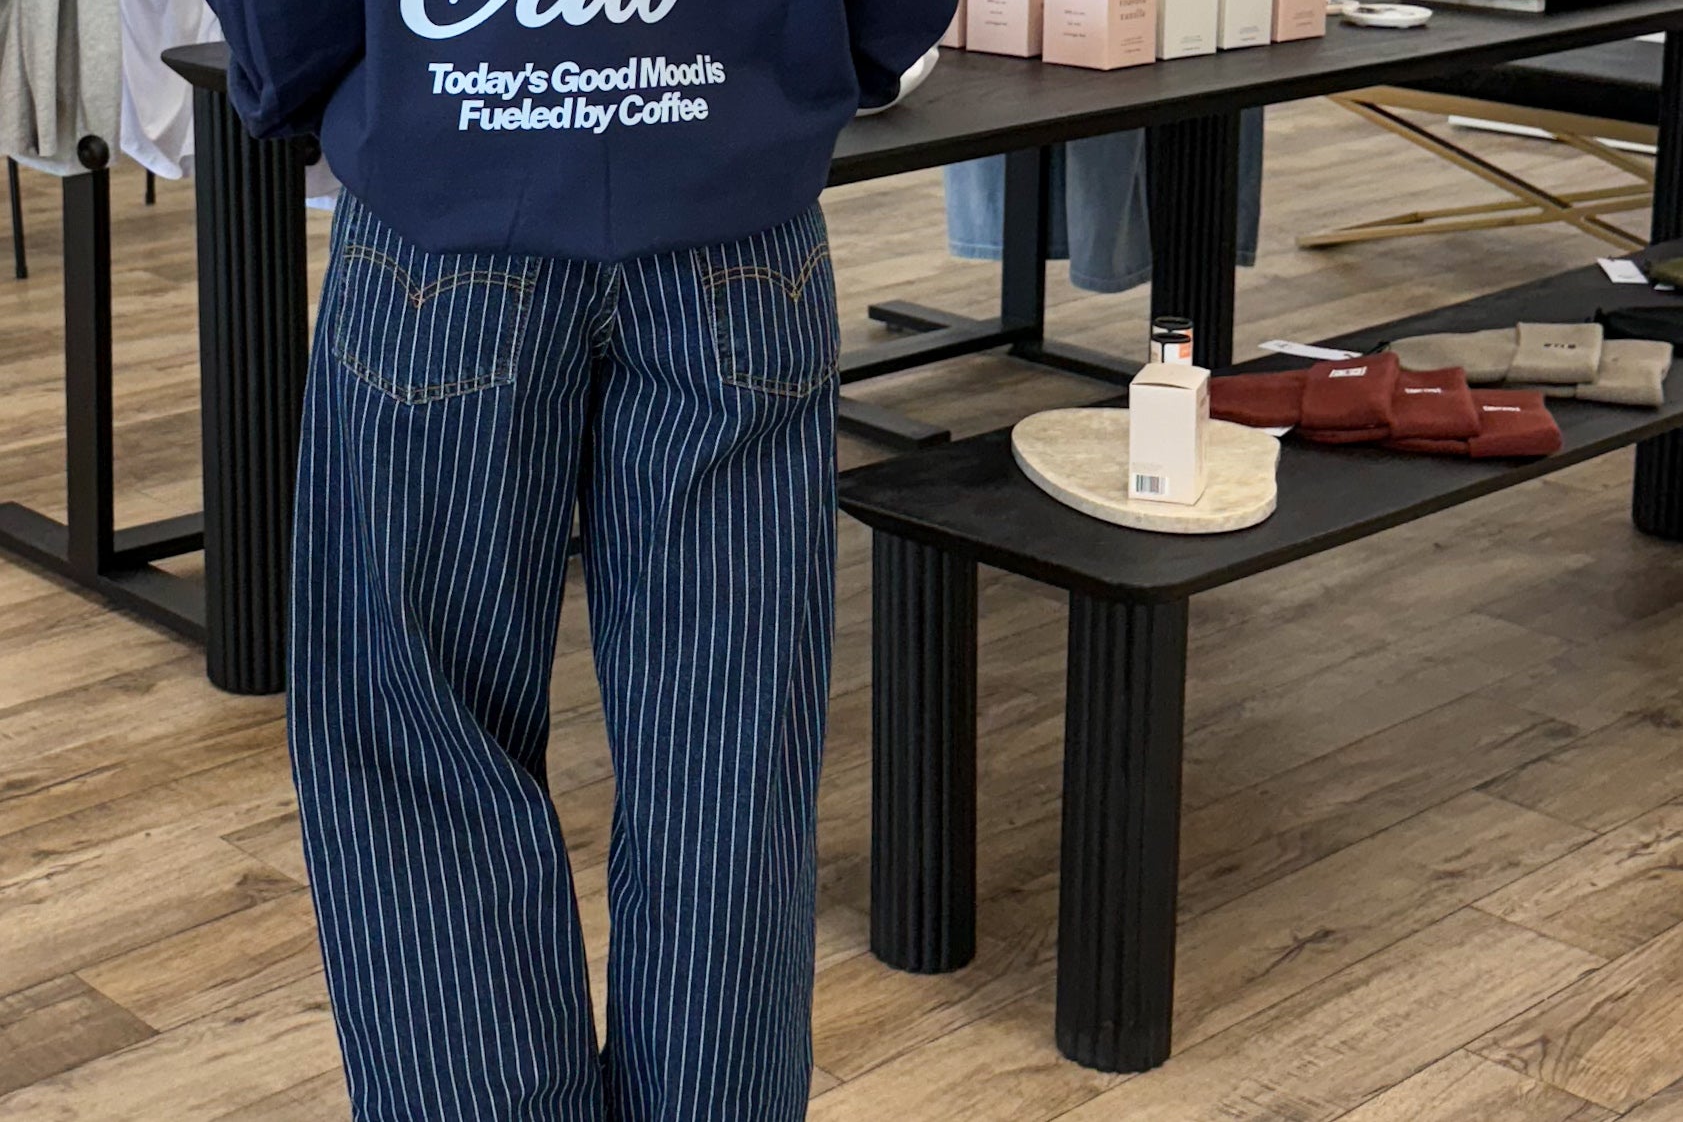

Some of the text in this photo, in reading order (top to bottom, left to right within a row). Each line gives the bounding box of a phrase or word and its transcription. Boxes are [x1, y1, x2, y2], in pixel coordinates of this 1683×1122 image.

[428, 62, 549, 101] Today's
[550, 57, 638, 93] Good
[458, 91, 709, 134] Fueled by Coffee
